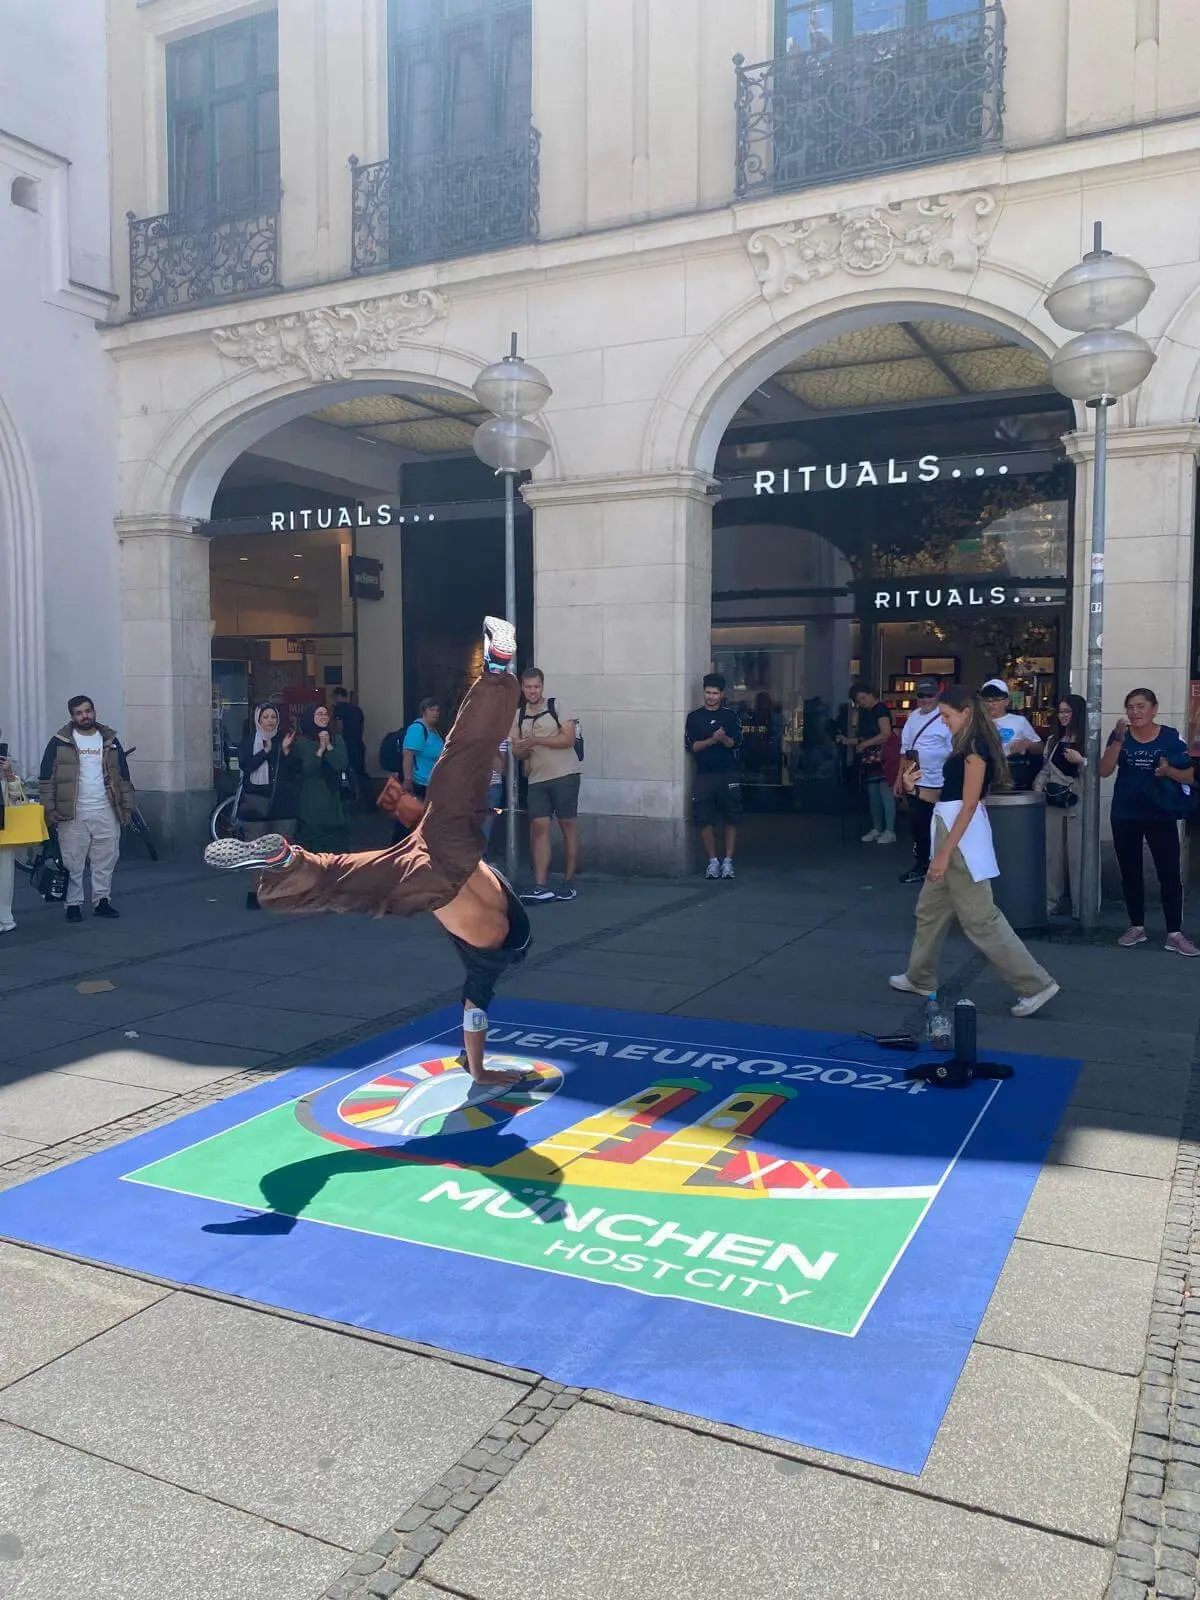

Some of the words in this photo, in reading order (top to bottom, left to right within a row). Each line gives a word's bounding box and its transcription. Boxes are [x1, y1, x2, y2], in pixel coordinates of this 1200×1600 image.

[753, 455, 1008, 496] RITUALS...
[271, 504, 435, 531] RITUALS...
[874, 586, 1052, 609] RITUALS...
[485, 1028, 609, 1057] UEFA
[612, 1044, 788, 1076] EURO
[782, 1064, 931, 1095] 2024
[418, 1180, 840, 1281] MÜNCHEN
[543, 1239, 685, 1280] HOST
[684, 1268, 814, 1305] CITY
